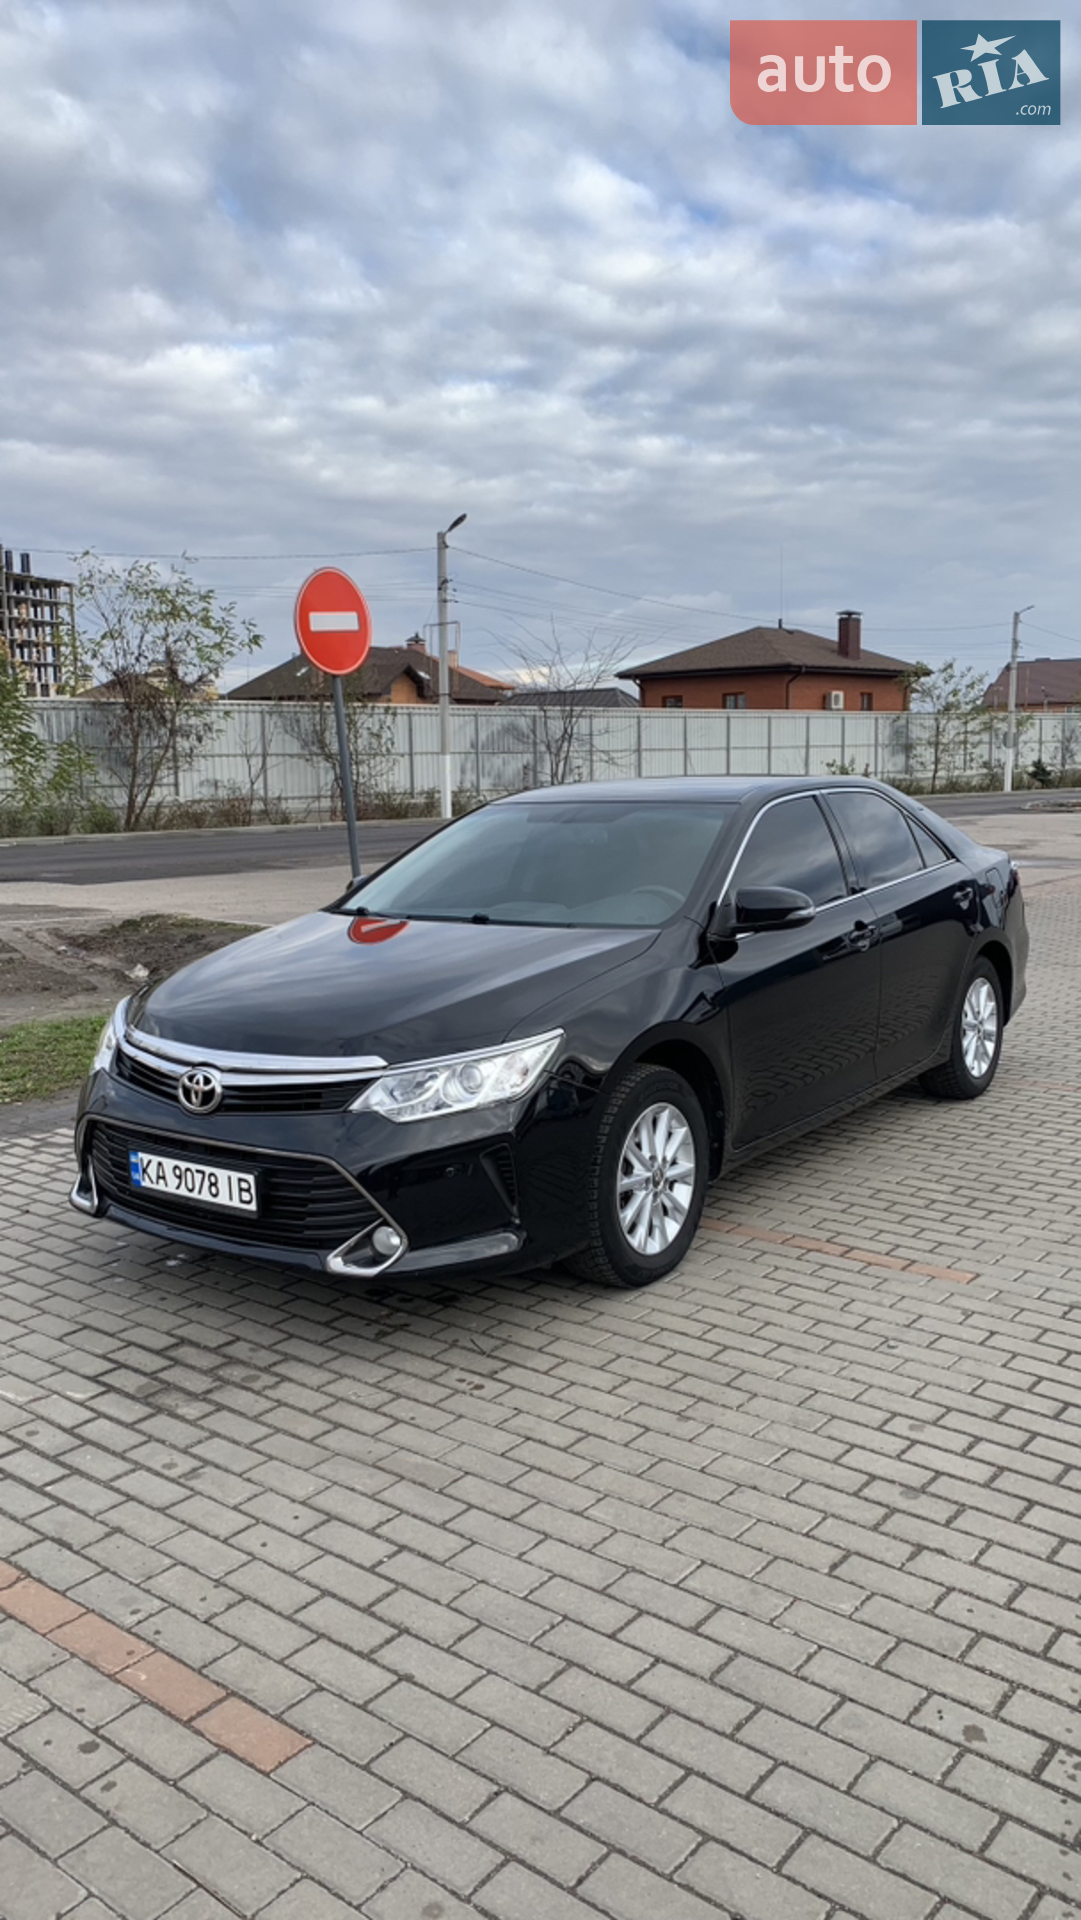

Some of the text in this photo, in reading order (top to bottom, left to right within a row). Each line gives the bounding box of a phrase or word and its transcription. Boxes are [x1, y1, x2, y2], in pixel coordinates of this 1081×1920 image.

[140, 1157, 253, 1205] KA 9078 IB
